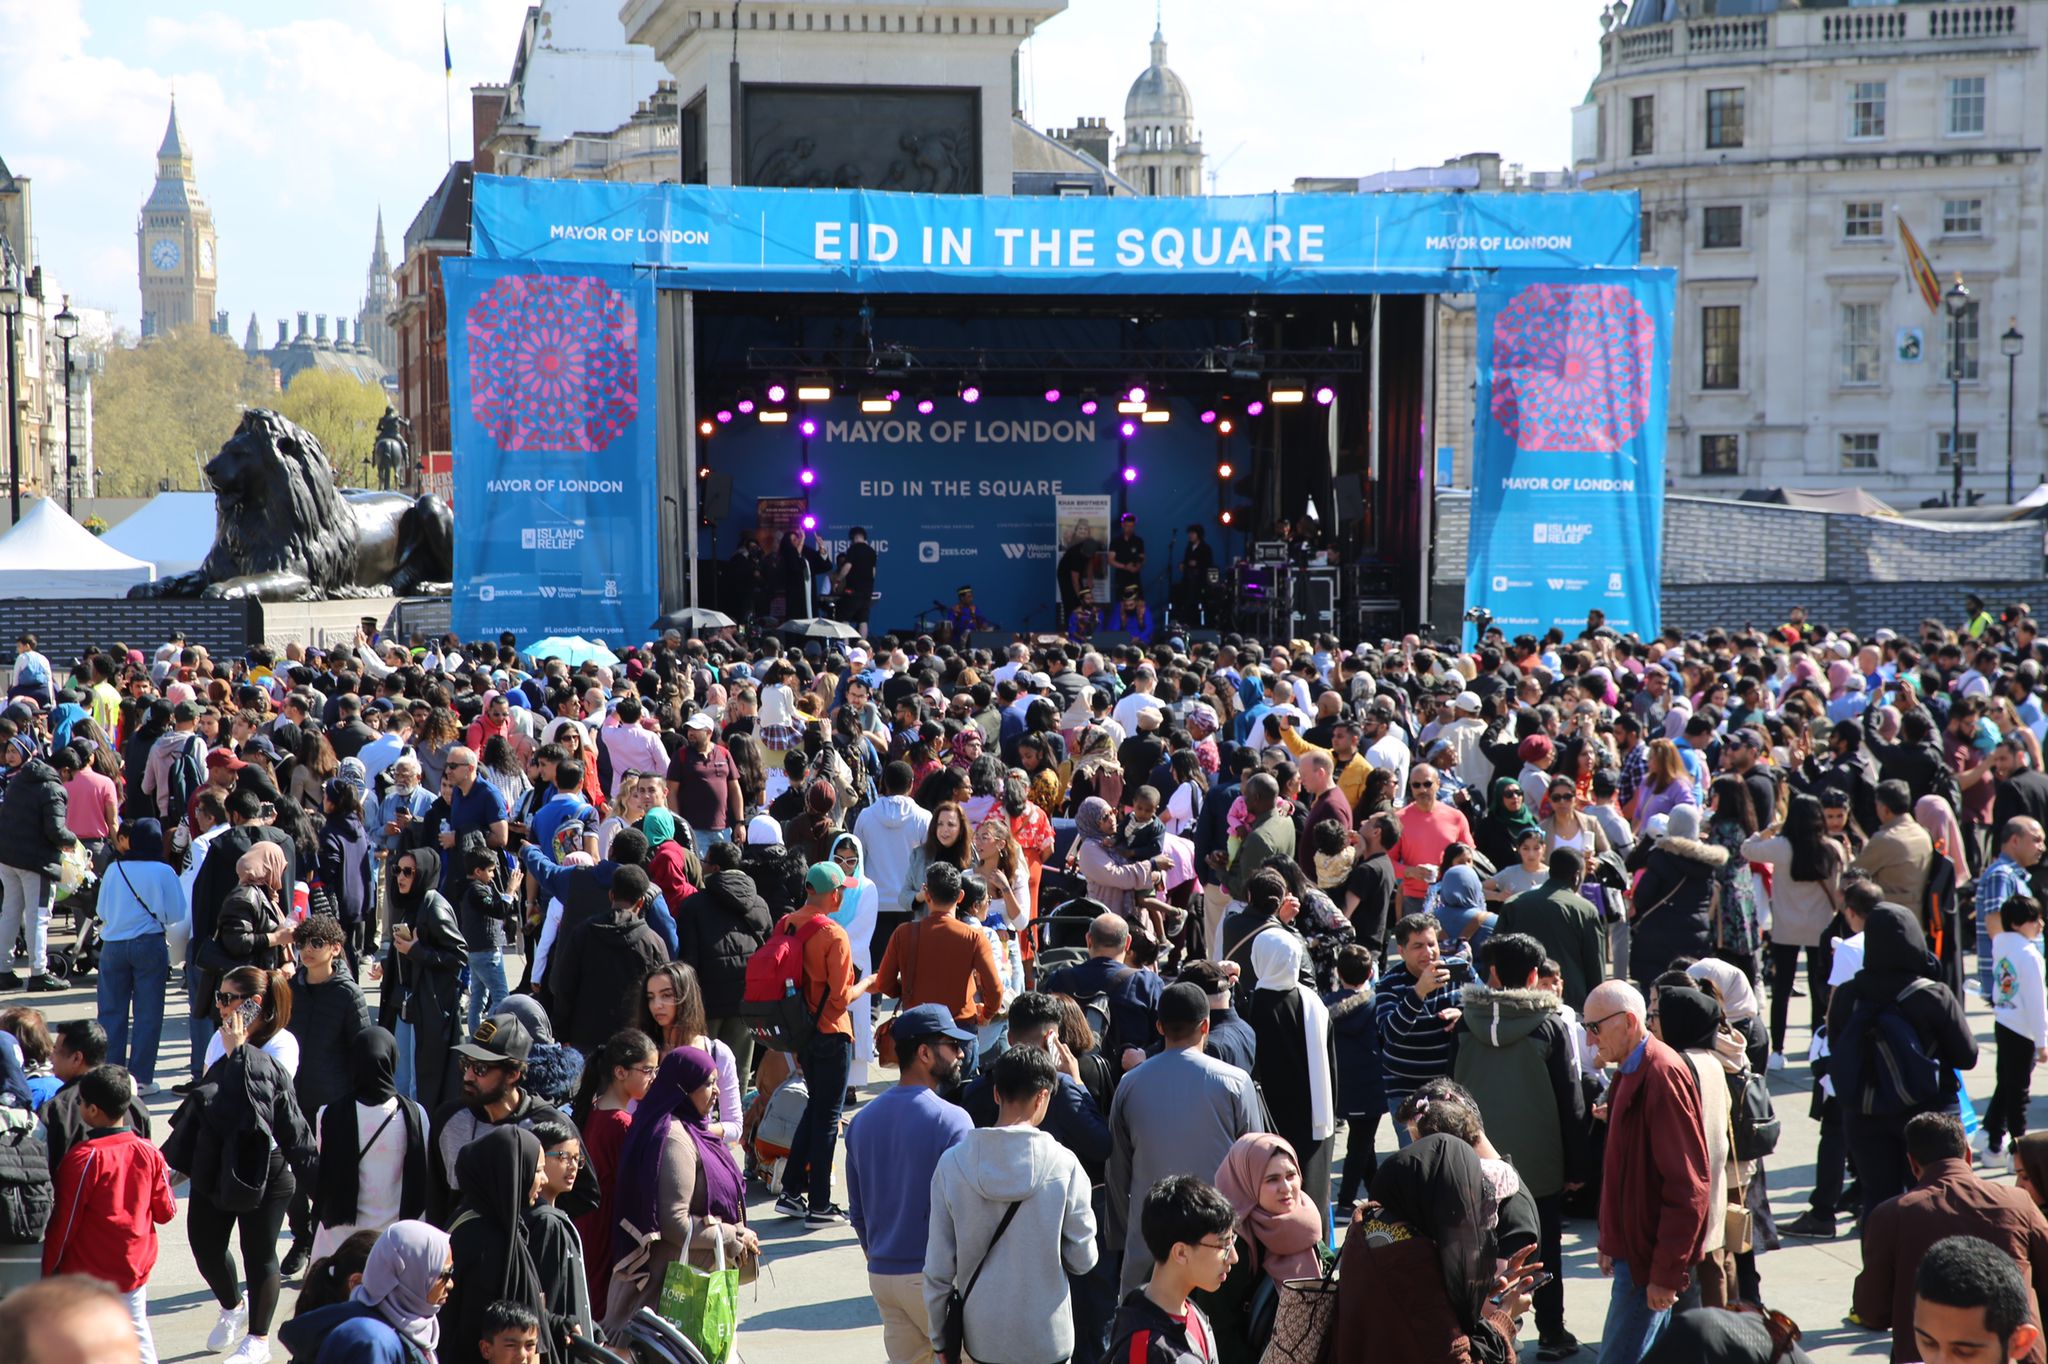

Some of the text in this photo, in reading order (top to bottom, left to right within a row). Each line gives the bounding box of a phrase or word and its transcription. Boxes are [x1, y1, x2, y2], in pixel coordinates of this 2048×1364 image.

[549, 224, 710, 245] MAYOR OF LONDON
[815, 222, 1325, 269] EID IN THE SQUARE
[1426, 236, 1571, 251] MAYOR OF LONDON
[825, 420, 1096, 443] MAYOR OF LONDON
[486, 479, 623, 493] MAYOR OF LONDON
[860, 480, 1063, 497] EID IN THE SQUARE
[1502, 478, 1635, 492] MAYOR OF LONDON
[537, 528, 584, 540] ISLAMIC
[1548, 524, 1592, 535] ISLAMIC
[1548, 533, 1584, 544] RELIEF
[537, 539, 576, 550] RELIEF
[940, 548, 978, 556] ZEES.COM
[1026, 551, 1051, 559] Union
[557, 587, 583, 595] Western
[481, 626, 494, 635] Eid
[543, 626, 624, 635] #LondonForEveryone
